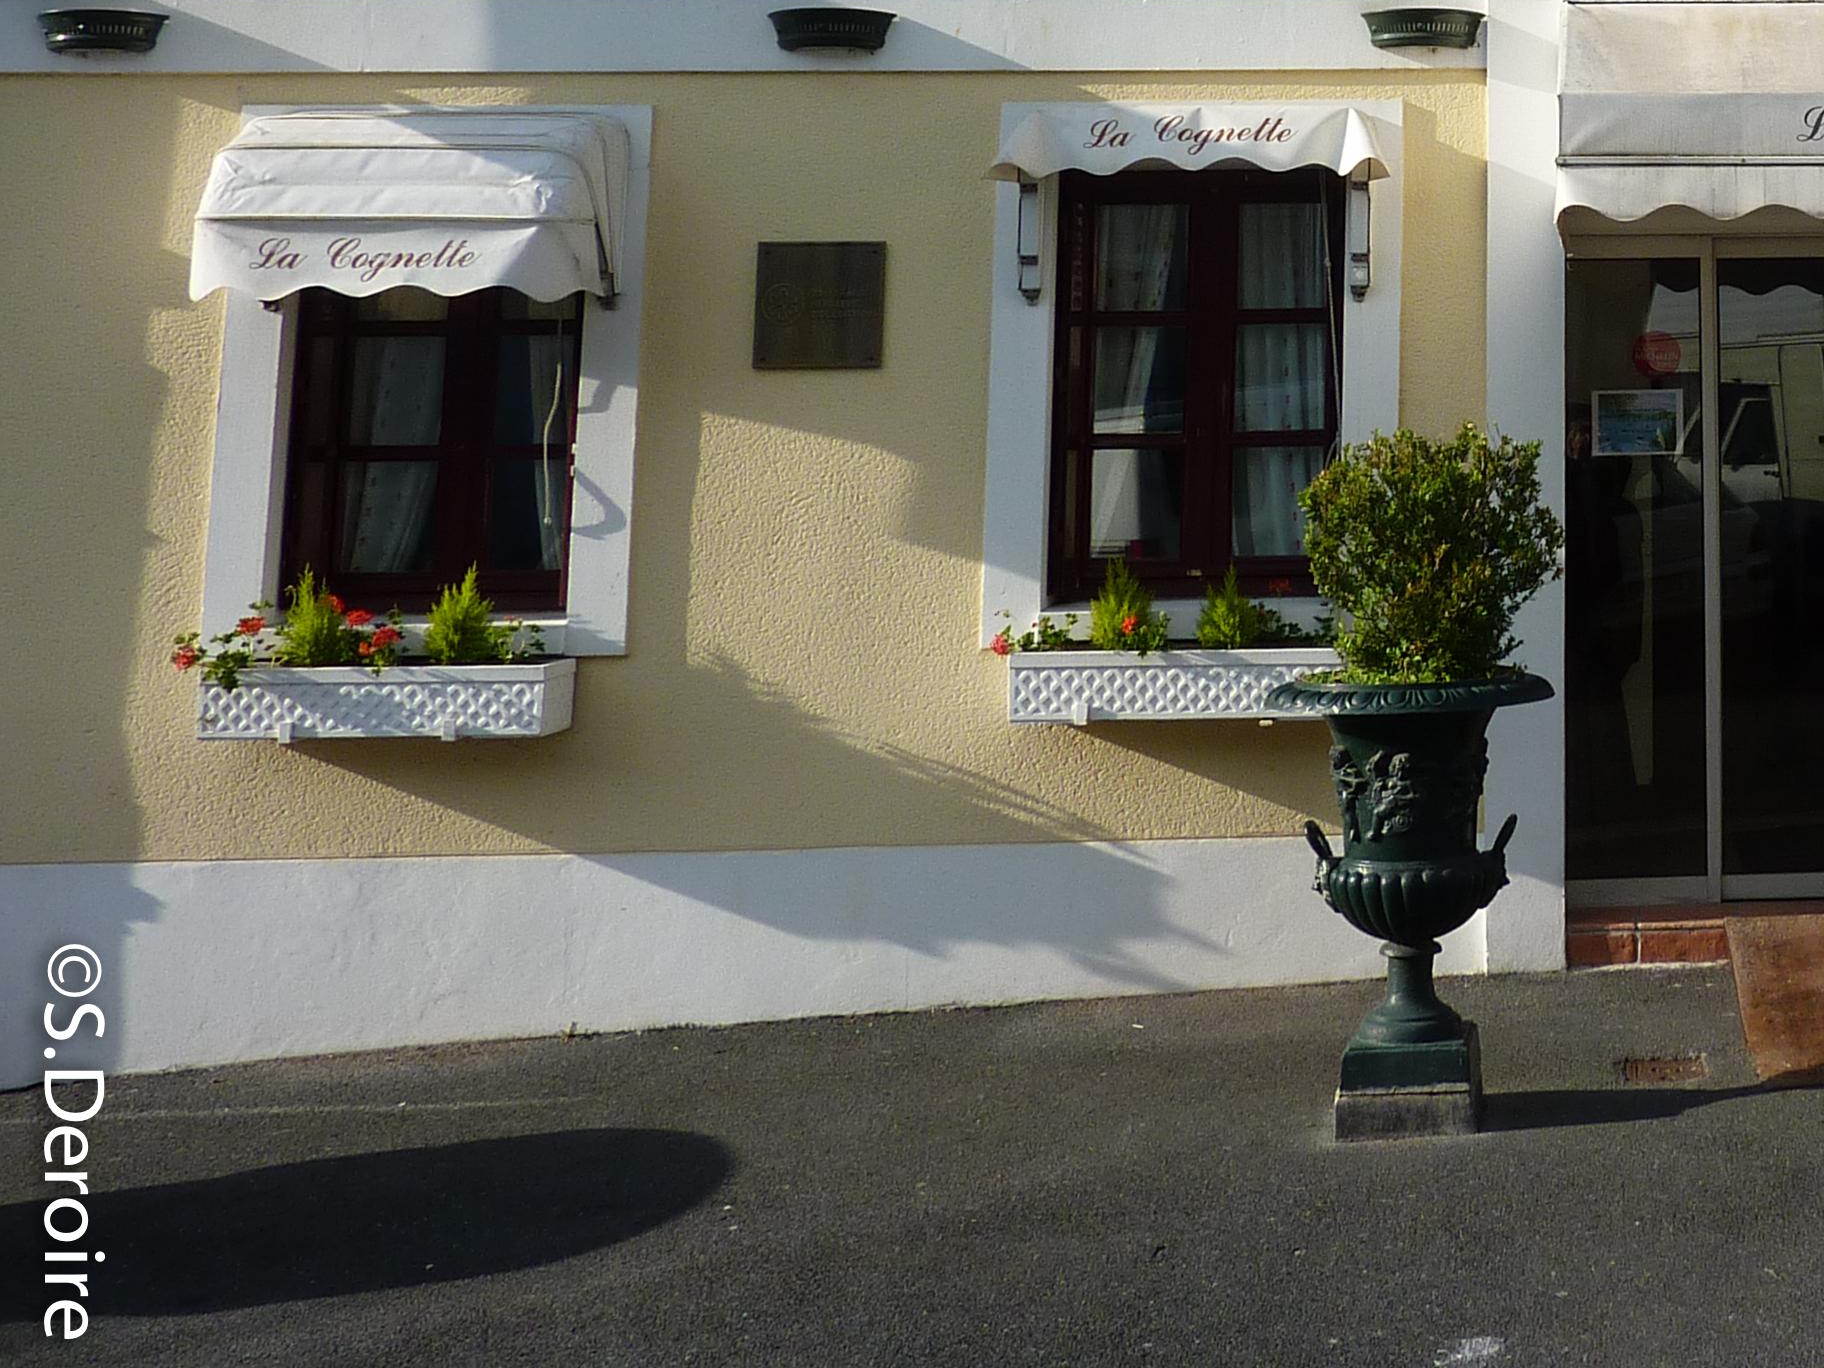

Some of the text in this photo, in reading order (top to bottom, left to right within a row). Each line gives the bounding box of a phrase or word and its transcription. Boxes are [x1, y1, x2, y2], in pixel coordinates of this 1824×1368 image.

[1082, 114, 1298, 156] La Cognette
[249, 237, 482, 282] La Cognette
